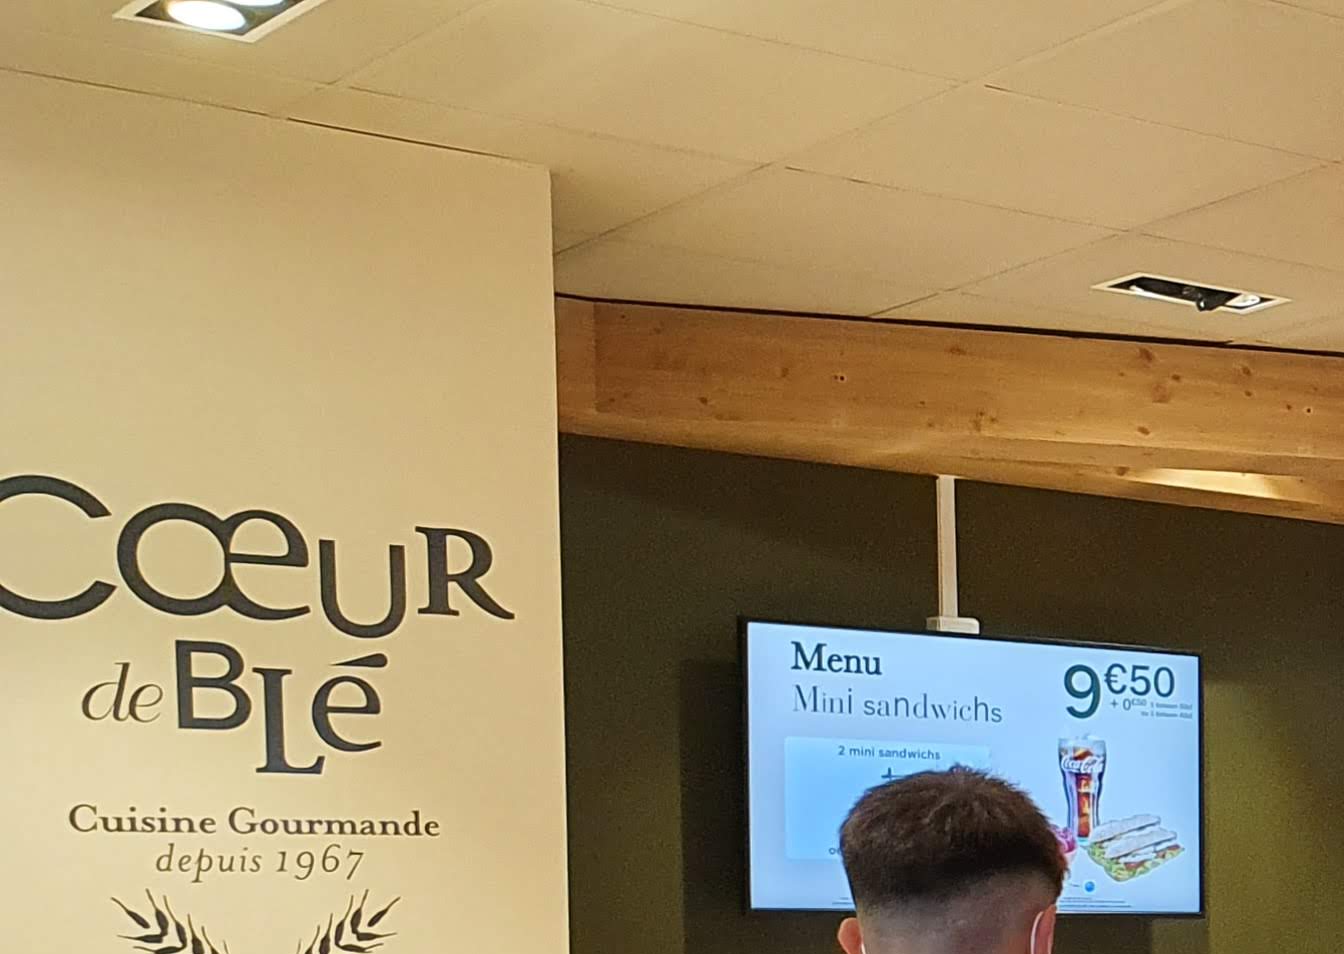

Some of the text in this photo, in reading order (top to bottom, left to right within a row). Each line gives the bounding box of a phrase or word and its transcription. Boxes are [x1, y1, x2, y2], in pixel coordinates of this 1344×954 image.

[790, 641, 882, 676] Menu
[81, 662, 164, 723] de
[793, 684, 1003, 723] Mini sandwichs
[838, 746, 941, 760] 2 mini sandwichs
[68, 804, 441, 838] Cuisine Gourmande
[155, 842, 366, 883] depuis 1967
